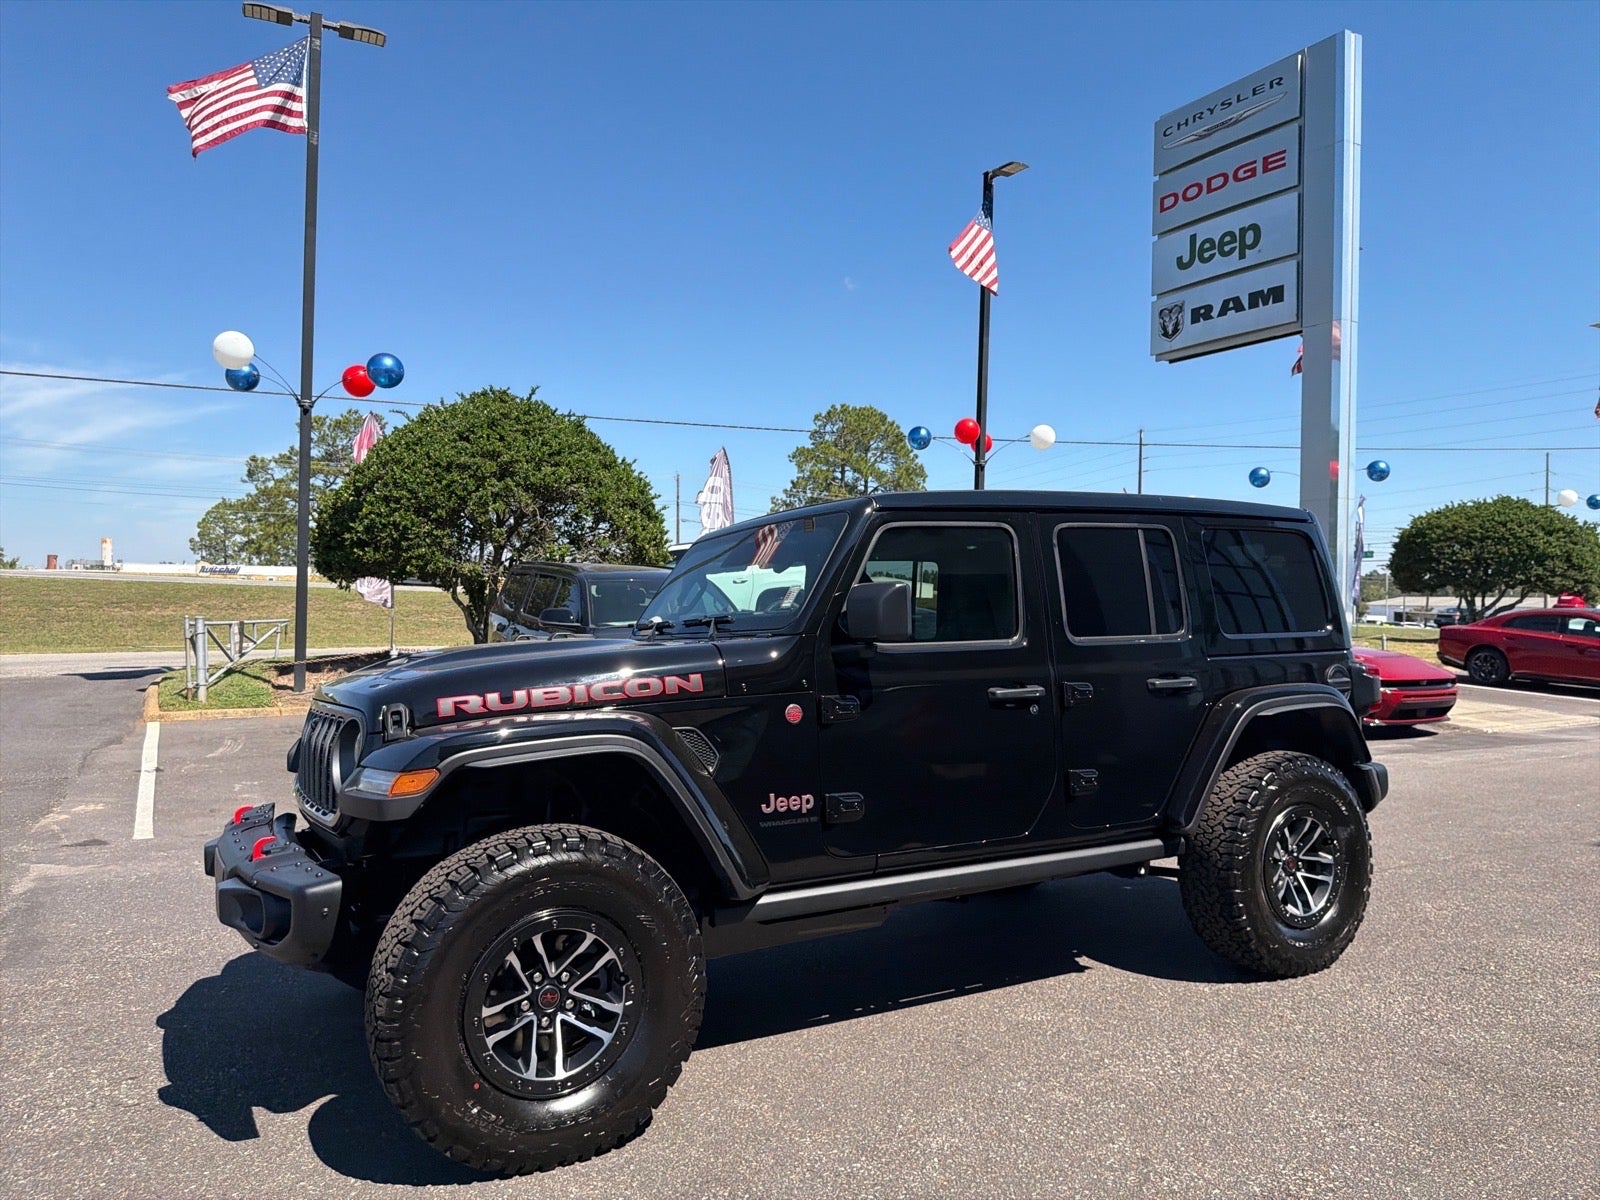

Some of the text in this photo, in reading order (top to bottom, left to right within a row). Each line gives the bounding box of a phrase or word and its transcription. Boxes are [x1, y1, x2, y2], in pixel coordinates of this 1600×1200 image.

[1162, 76, 1284, 138] CHRYSLER
[1159, 149, 1287, 213] DODGE
[1176, 222, 1262, 271] Jeep
[1190, 285, 1286, 325] RAM
[199, 565, 241, 575] Twitchell
[436, 673, 704, 718] RUBICON
[759, 817, 809, 828] WRANGLER
[760, 793, 815, 814] Jeep
